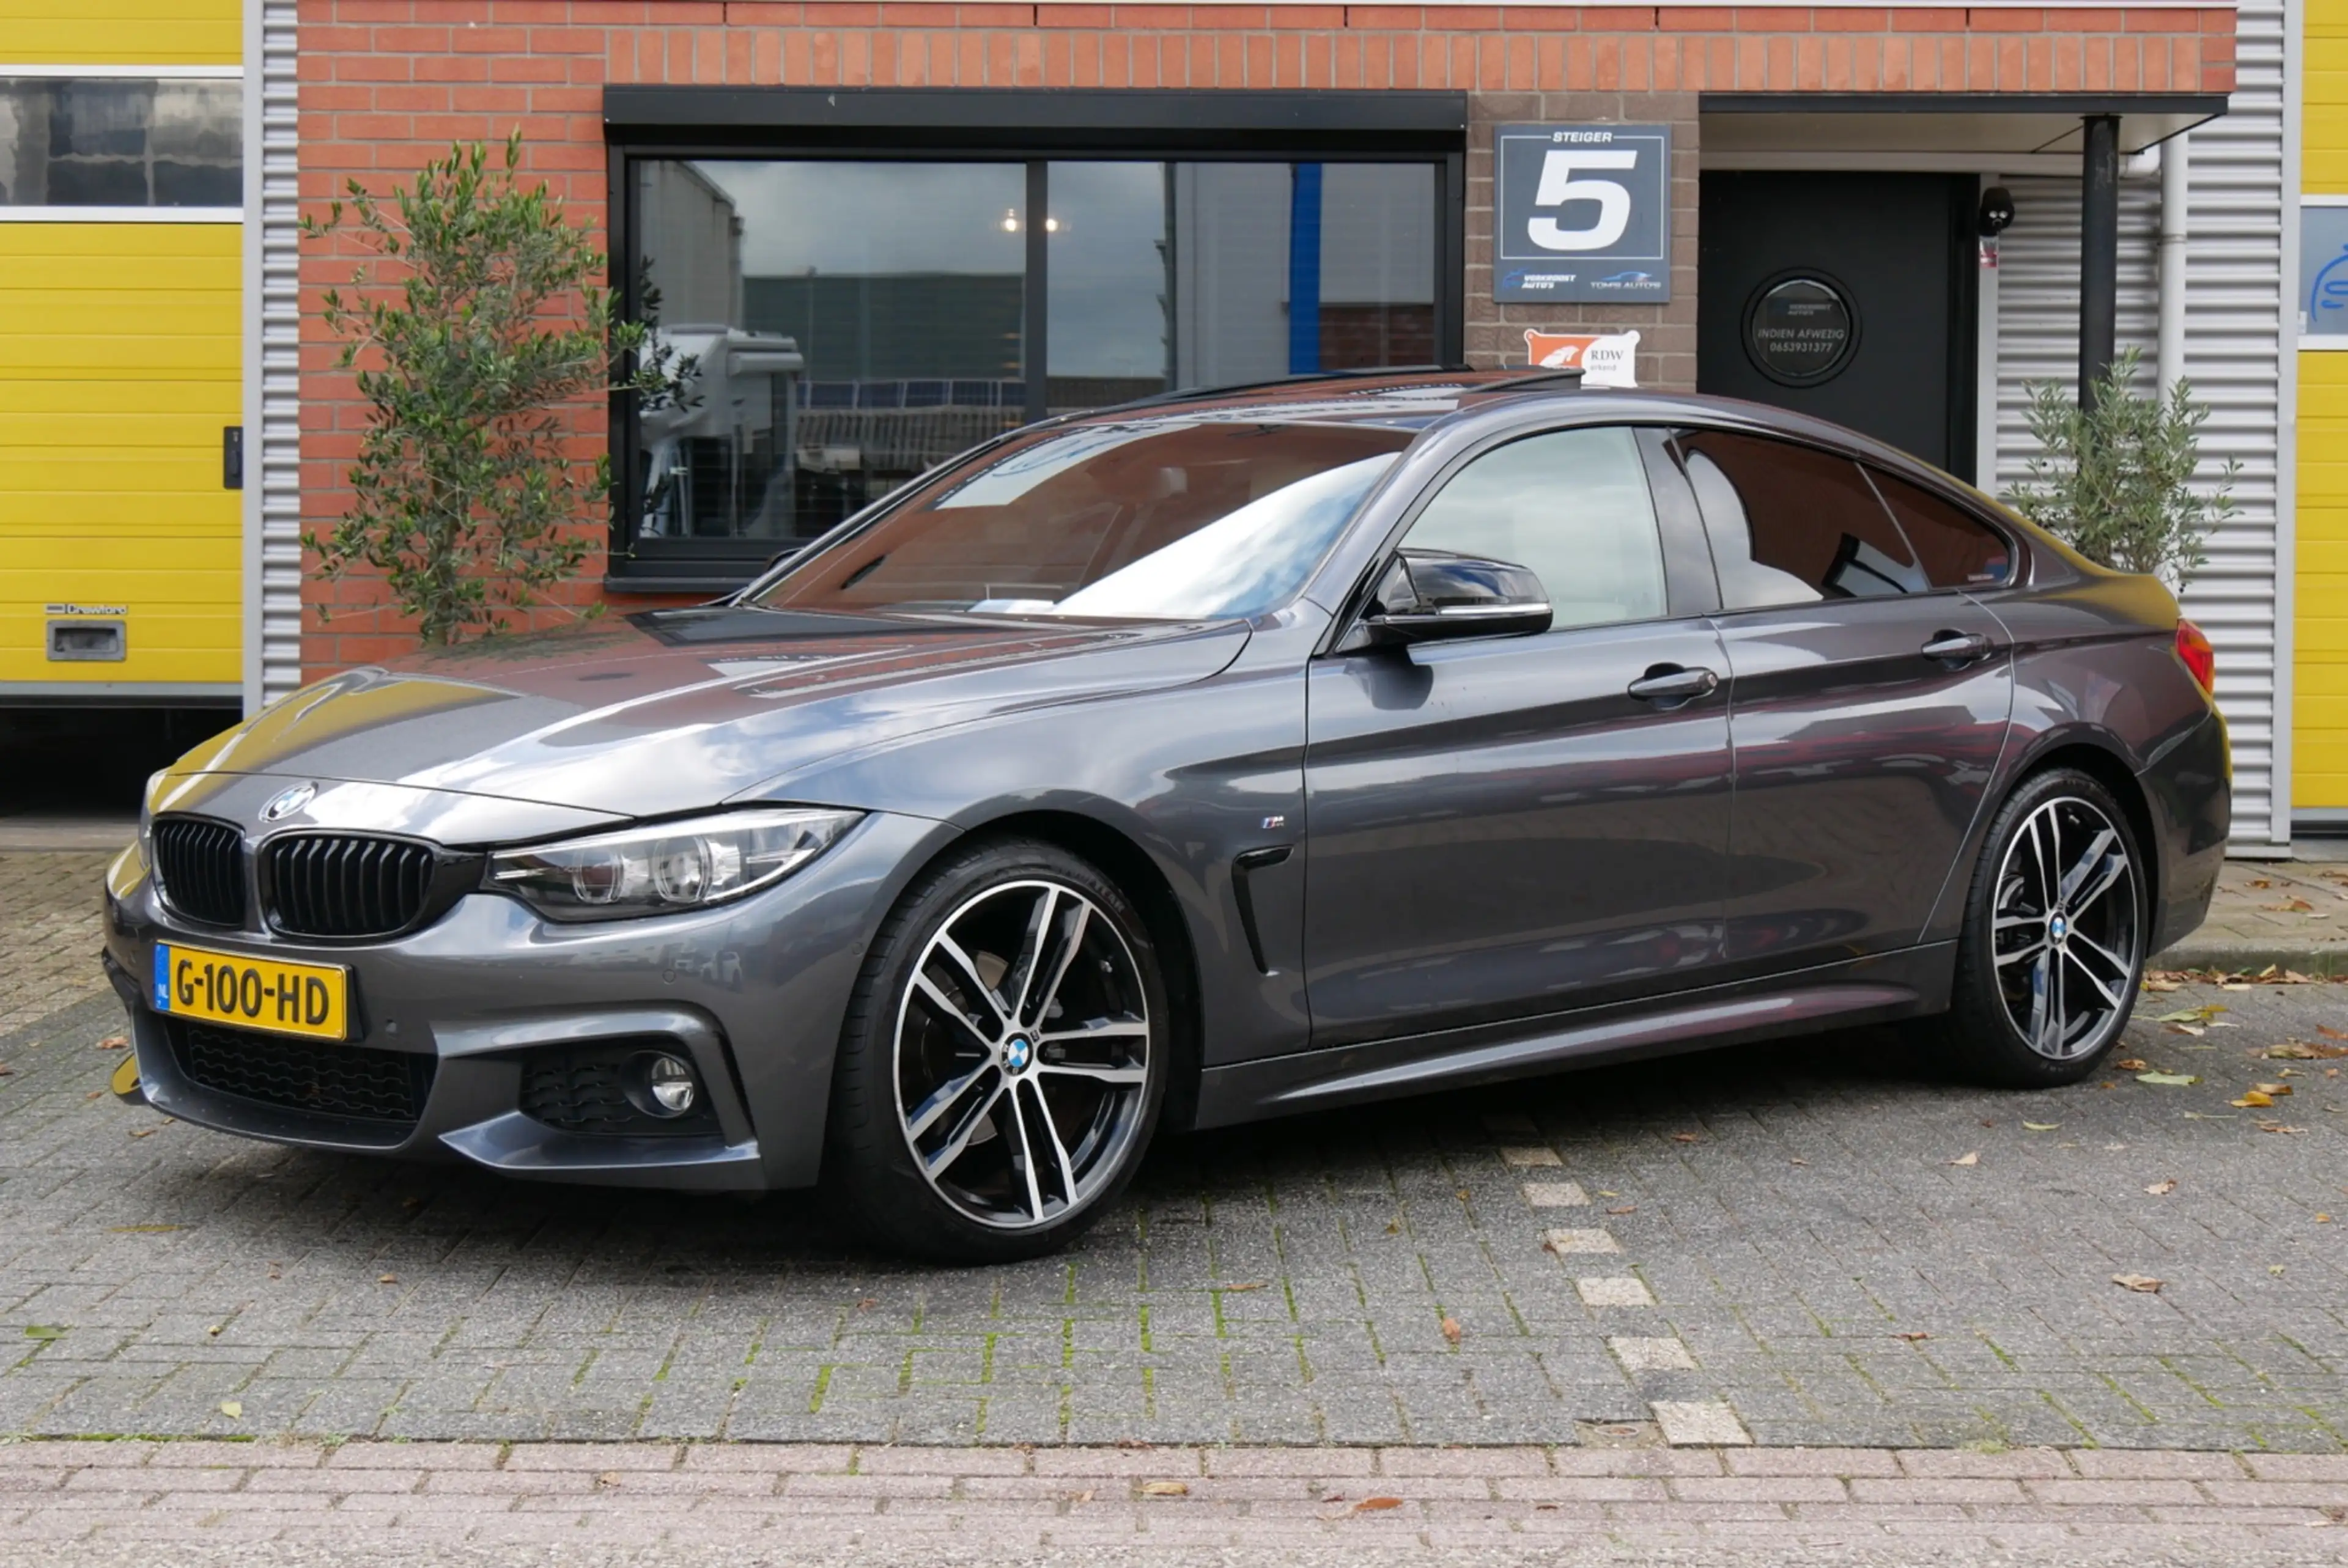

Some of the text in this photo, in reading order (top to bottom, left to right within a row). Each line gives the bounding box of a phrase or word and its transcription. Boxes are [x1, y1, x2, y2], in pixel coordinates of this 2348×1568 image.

[1552, 131, 1612, 142] STEIGER
[1527, 150, 1637, 250] 5
[1758, 328, 1845, 339] INDIEN AFWEZIG
[1590, 350, 1624, 360] RDW
[177, 959, 330, 1025] G-100-HD
